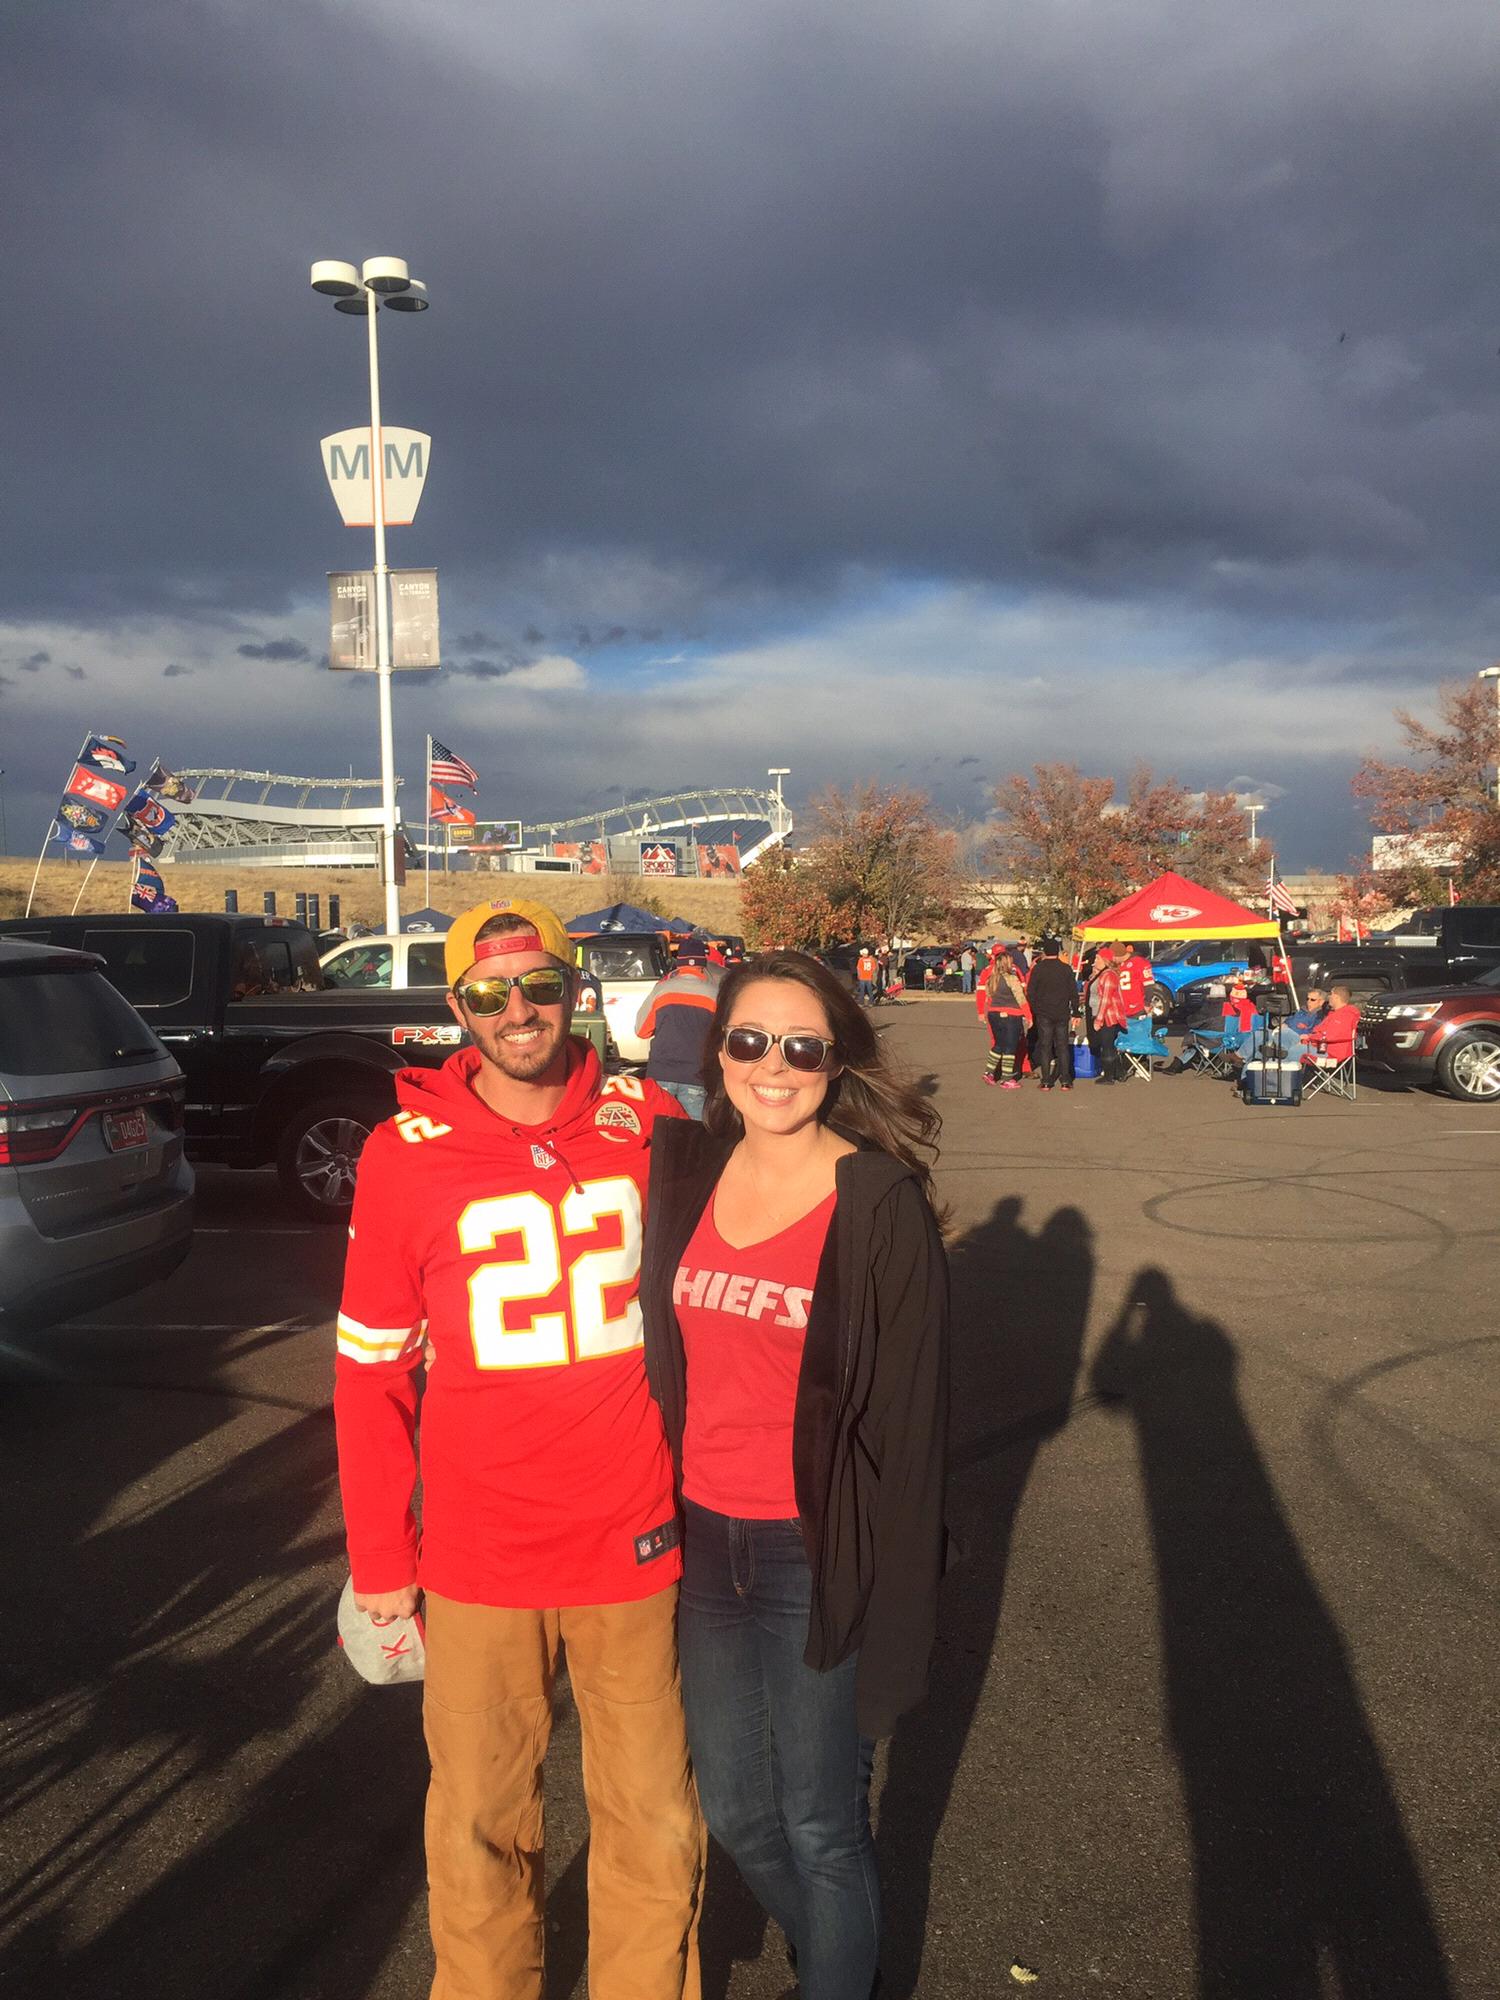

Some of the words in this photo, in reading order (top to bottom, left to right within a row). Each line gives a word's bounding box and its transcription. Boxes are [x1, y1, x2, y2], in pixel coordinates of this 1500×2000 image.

[337, 586, 367, 594] CANYON
[392, 1026, 461, 1045] FX4
[456, 1174, 645, 1370] 22
[672, 1266, 814, 1329] HIEFS
